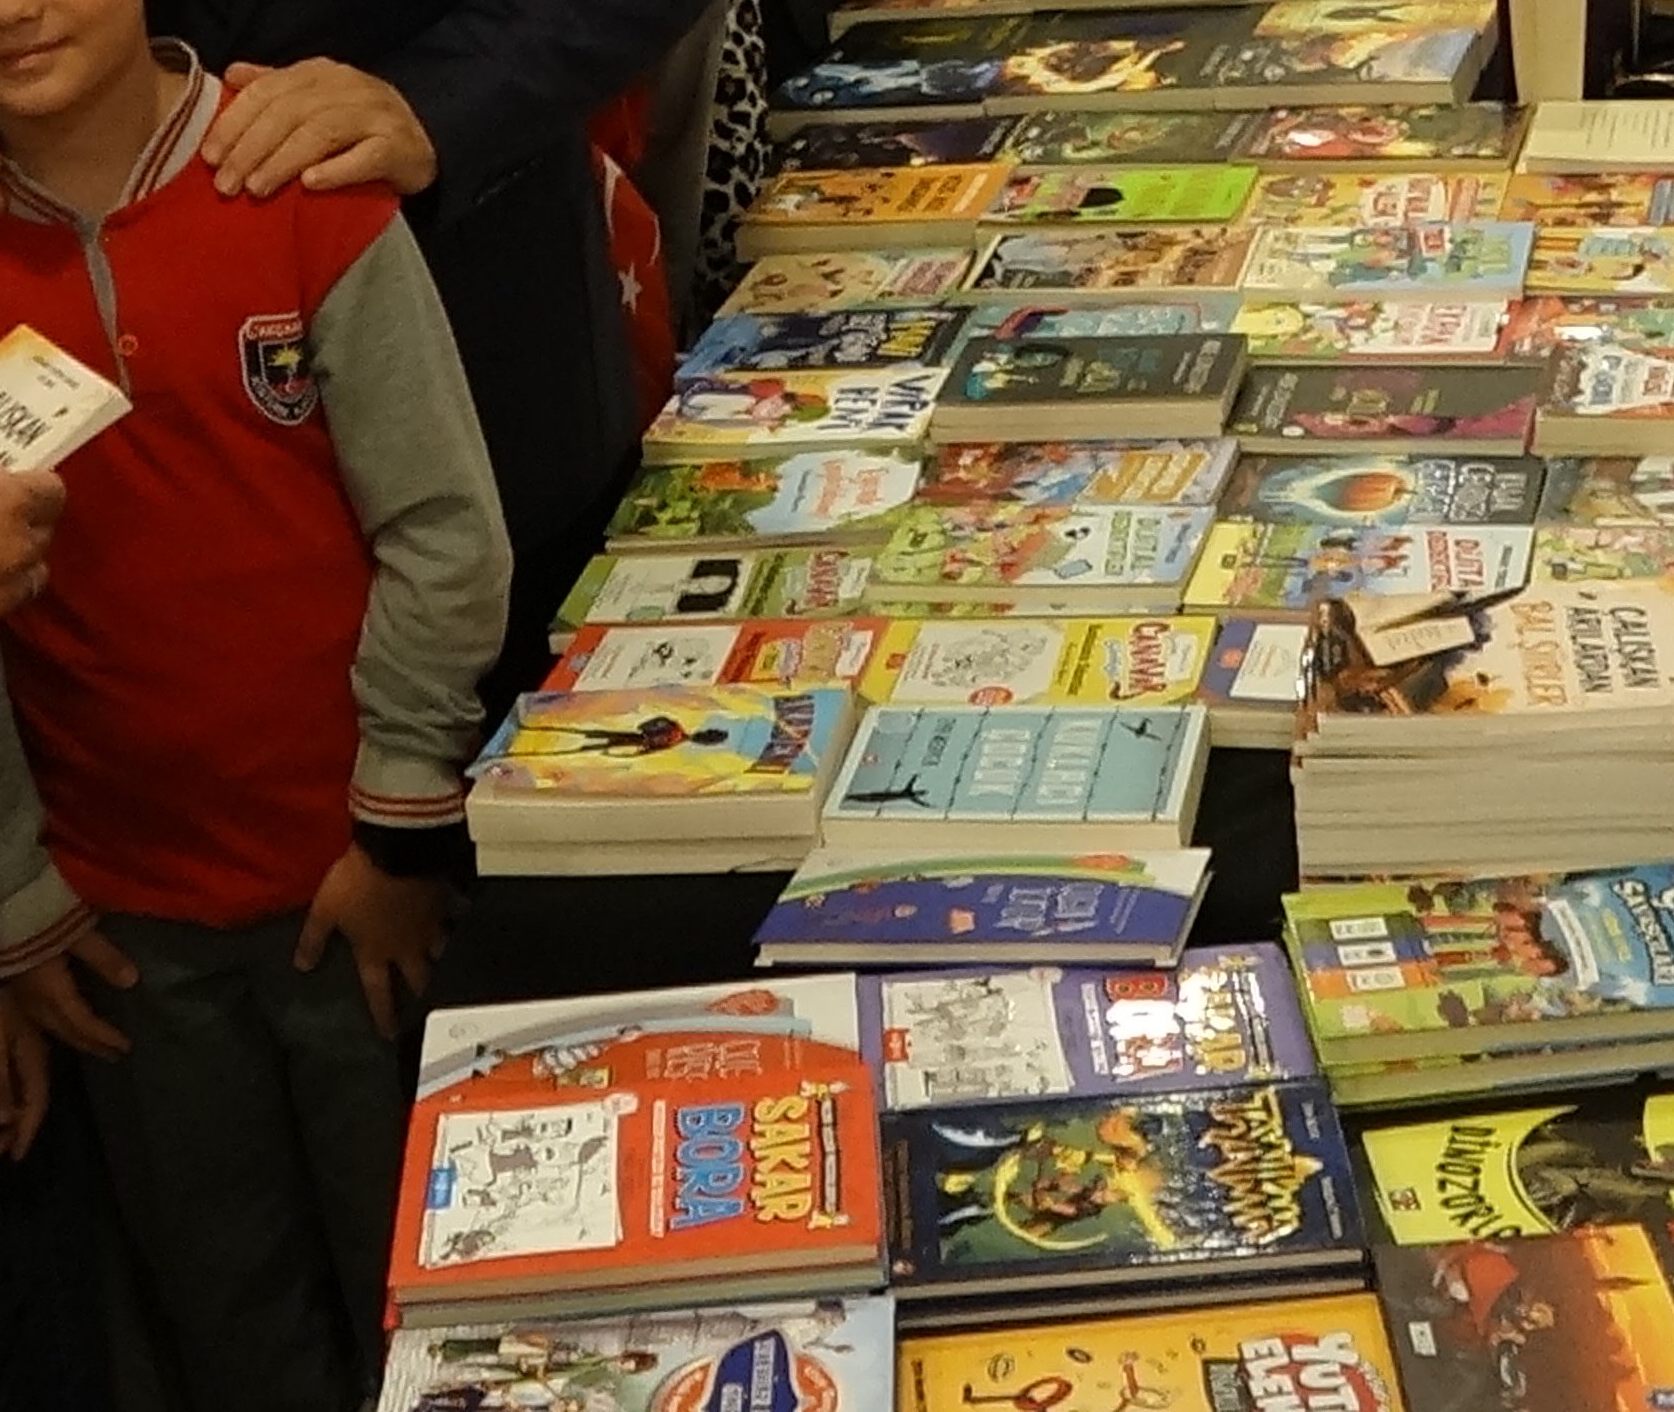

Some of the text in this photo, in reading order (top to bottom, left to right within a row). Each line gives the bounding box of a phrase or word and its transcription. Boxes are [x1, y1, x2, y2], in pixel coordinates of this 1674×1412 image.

[1453, 538, 1485, 590] DİJİTA
[1603, 605, 1661, 689] ÇALIŞKAN
[670, 1101, 749, 1231] BORA
[747, 1095, 813, 1223] SAKAR
